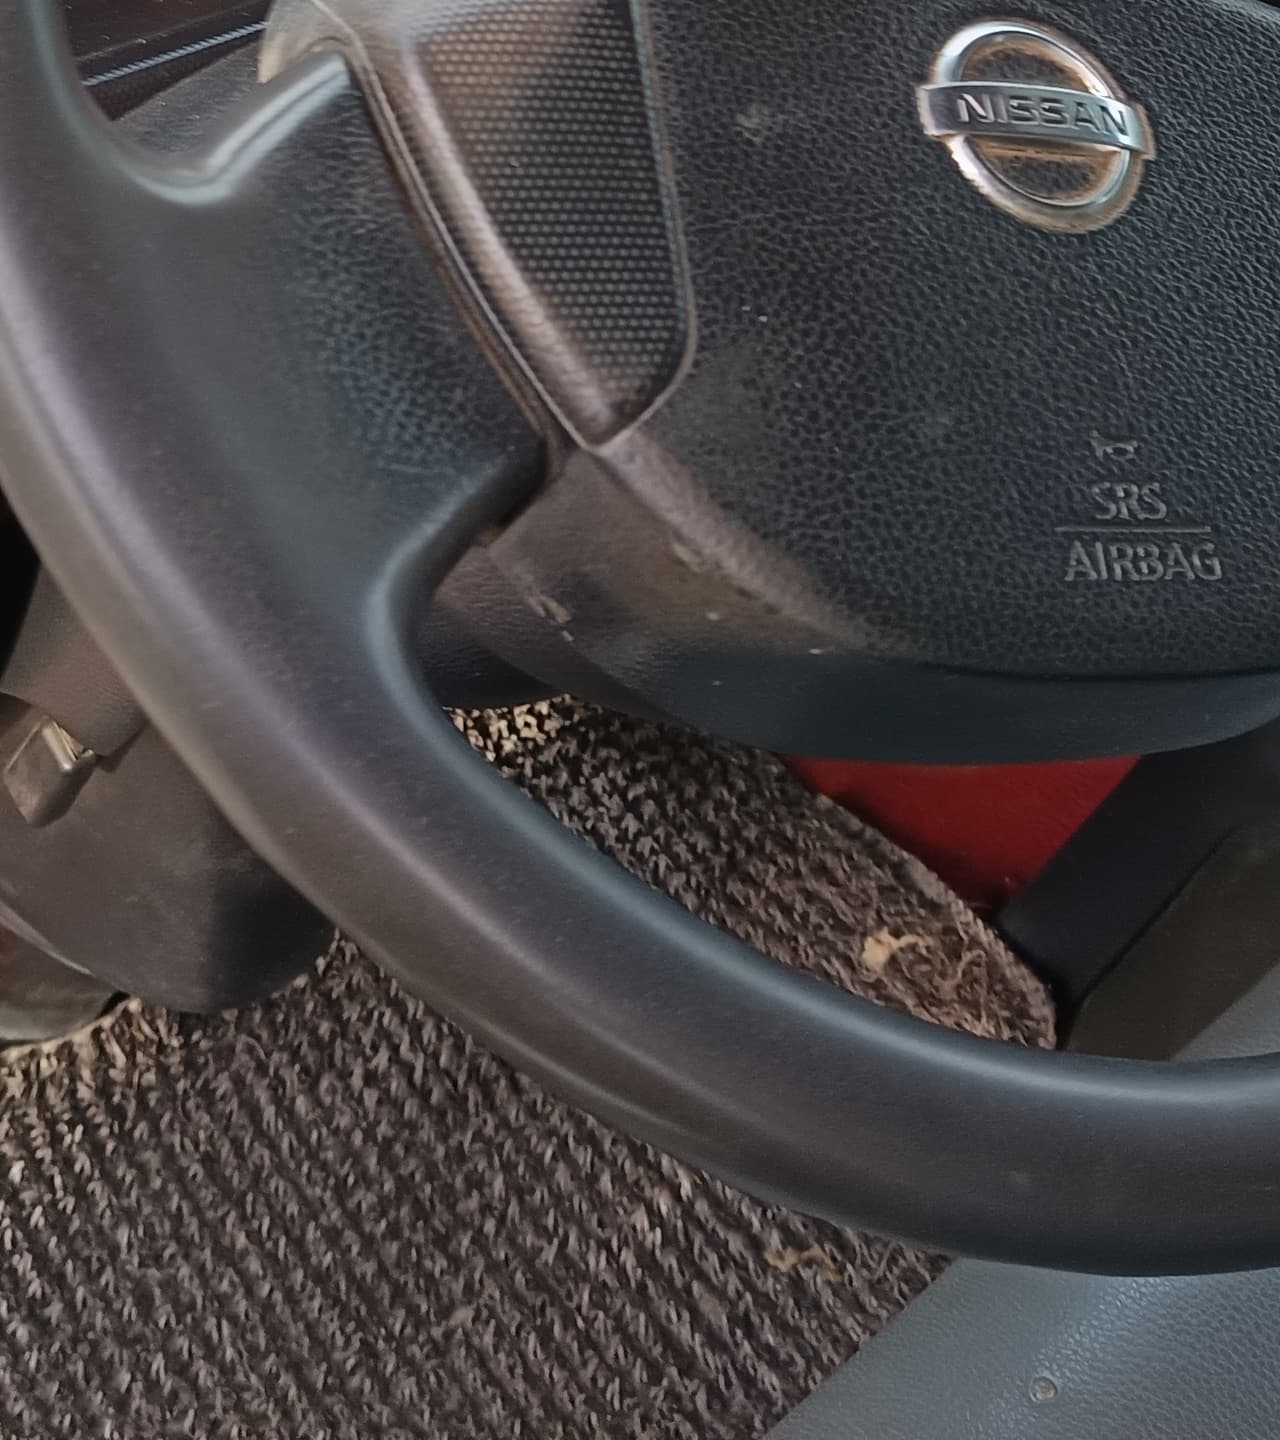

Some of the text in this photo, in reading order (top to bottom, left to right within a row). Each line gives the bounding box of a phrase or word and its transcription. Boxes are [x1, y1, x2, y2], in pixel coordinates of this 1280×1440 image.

[956, 92, 1130, 137] NISSAN
[1090, 481, 1168, 521] SRS
[1063, 539, 1223, 582] AIRBAG
